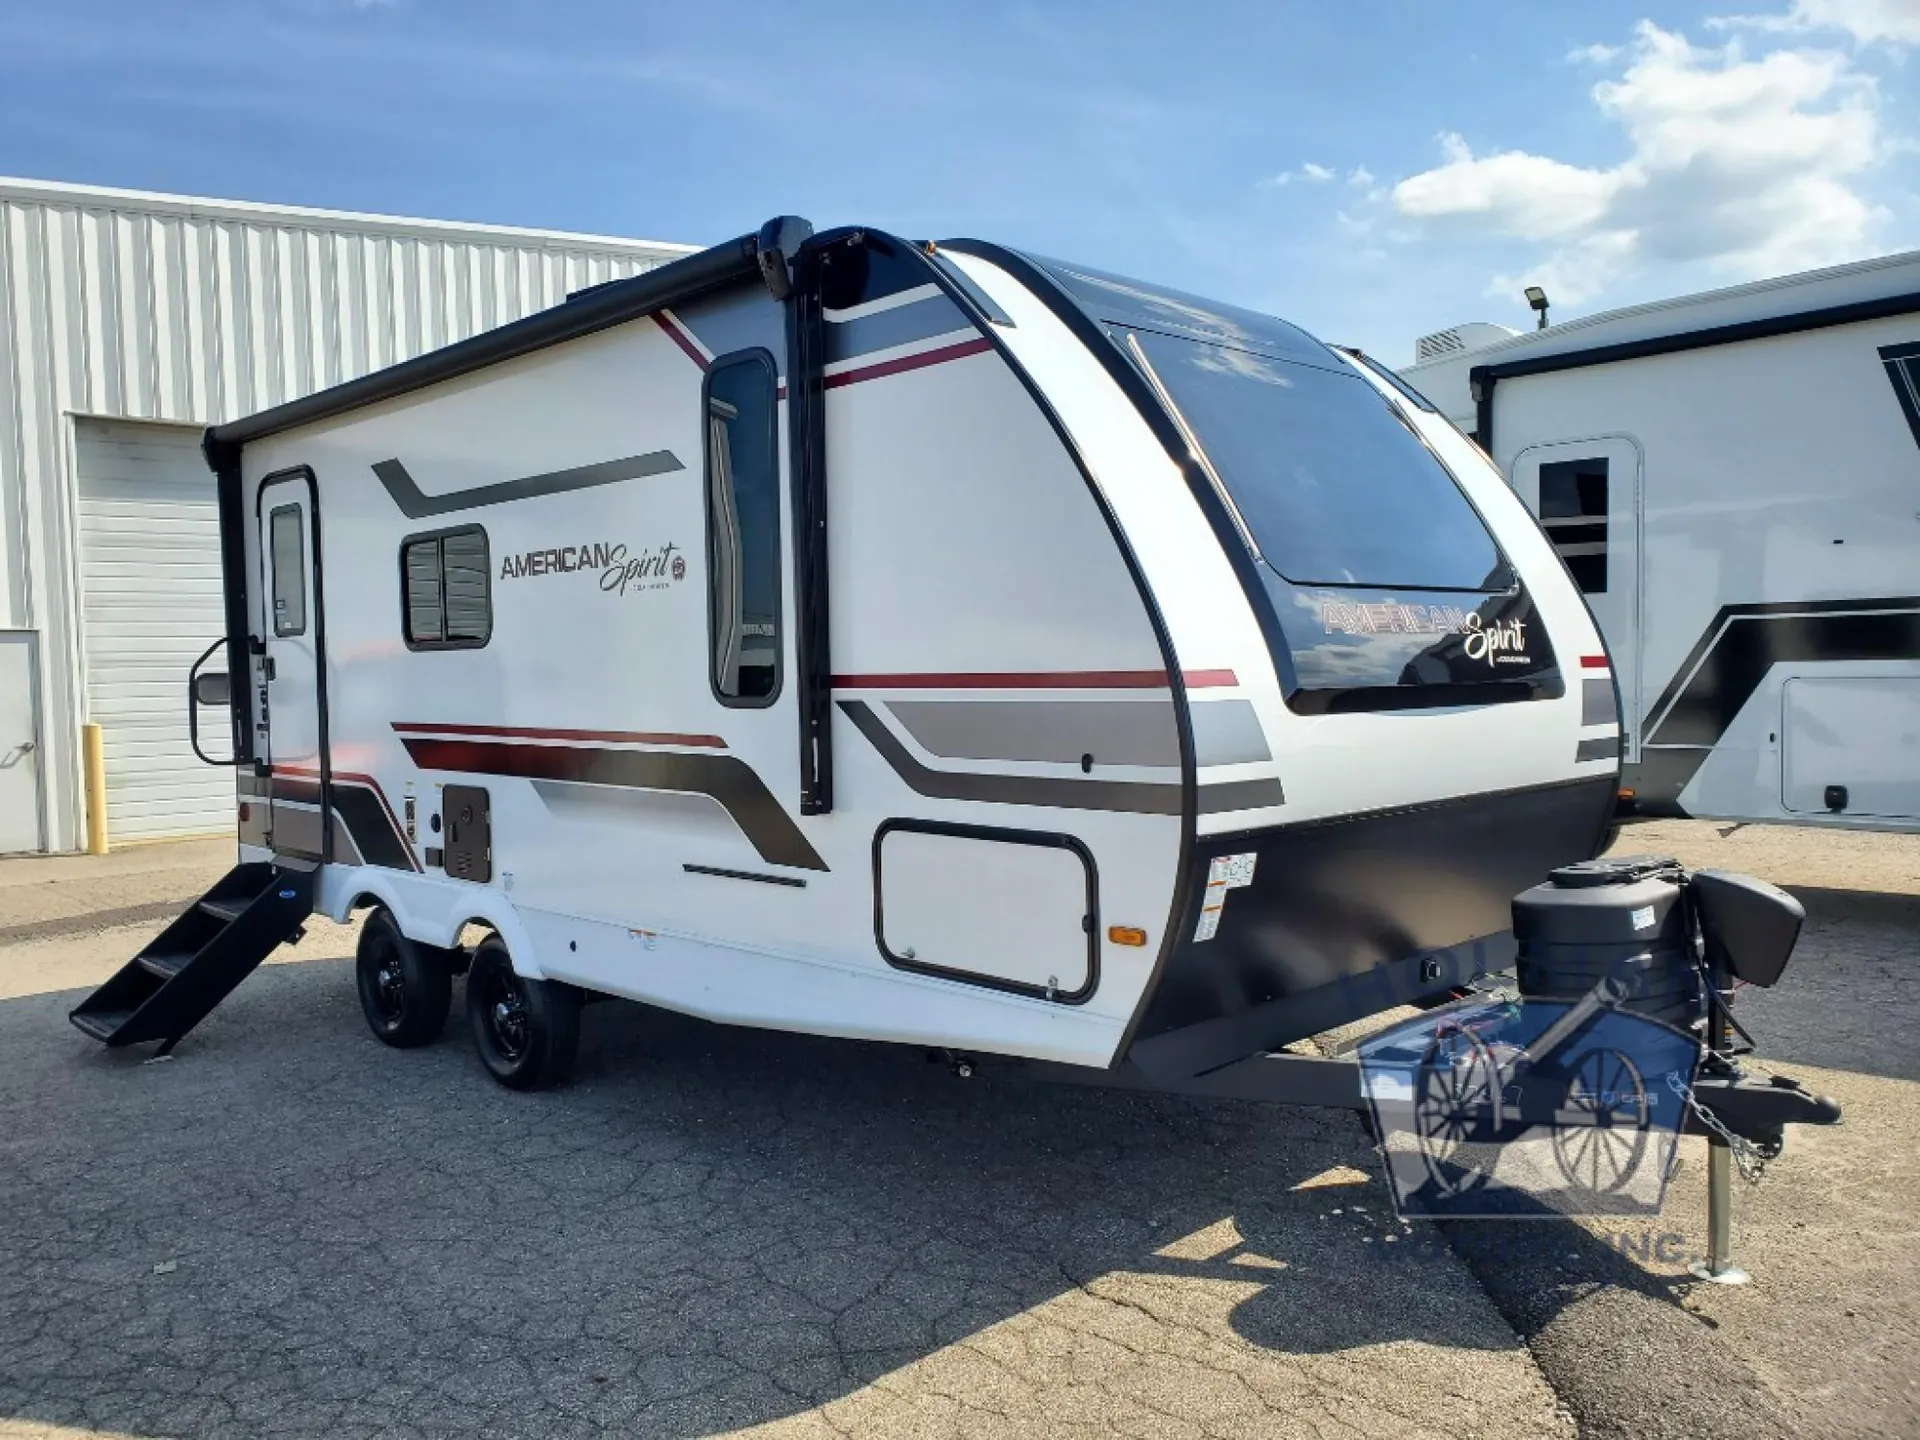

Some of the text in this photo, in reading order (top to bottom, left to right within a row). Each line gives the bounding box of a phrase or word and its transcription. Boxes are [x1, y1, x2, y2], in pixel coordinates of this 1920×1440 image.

[500, 541, 681, 596] AMERICAN Spirit
[1323, 602, 1527, 668] AMERICAN Spirit
